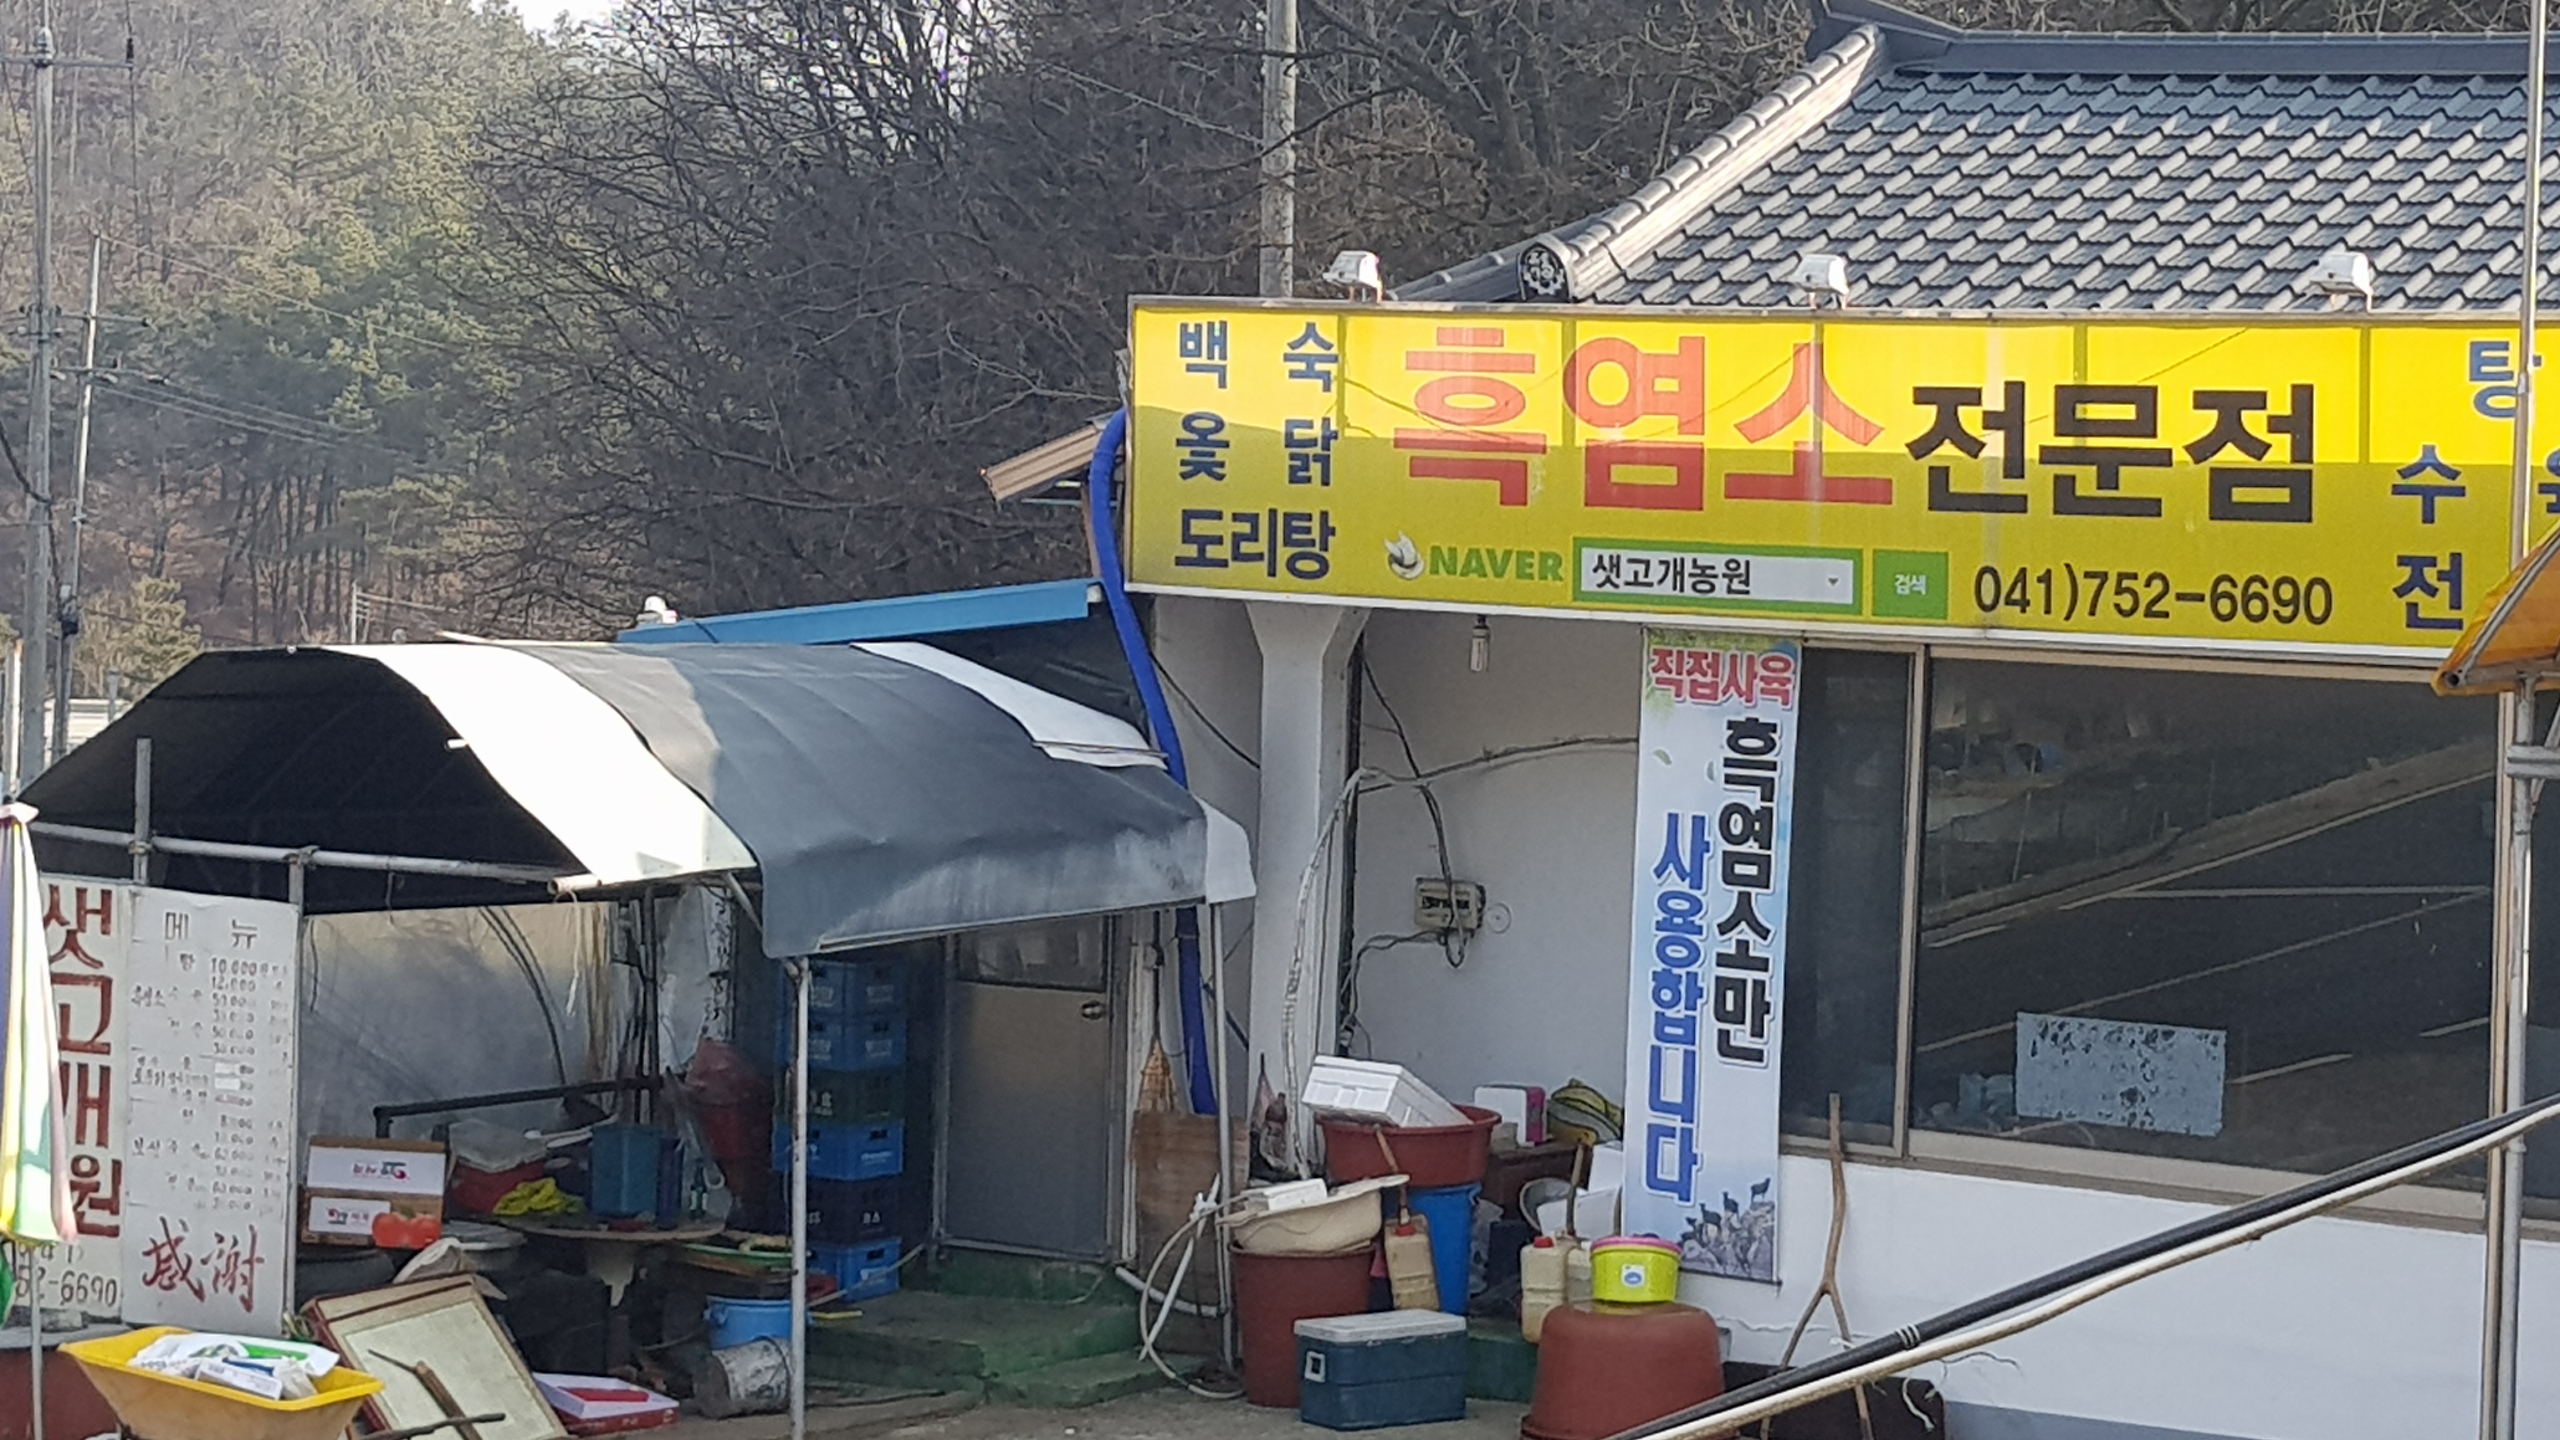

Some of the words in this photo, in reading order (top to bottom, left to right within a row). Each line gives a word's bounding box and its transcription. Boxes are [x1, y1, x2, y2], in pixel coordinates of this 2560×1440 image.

[1393, 325, 1893, 511] 흑염소
[1905, 379, 2315, 524] 전문점
[1174, 508, 1336, 580] 도리탕
[1428, 545, 1564, 582] NAVER
[1592, 553, 1751, 596] 샛고개농원
[1894, 571, 1927, 596] 검색
[1973, 562, 2334, 627] 041)752-6690
[1650, 647, 1795, 708] 직접사육
[1713, 716, 1778, 1063] 흑염소만
[1645, 811, 1711, 1202] 사용합니다
